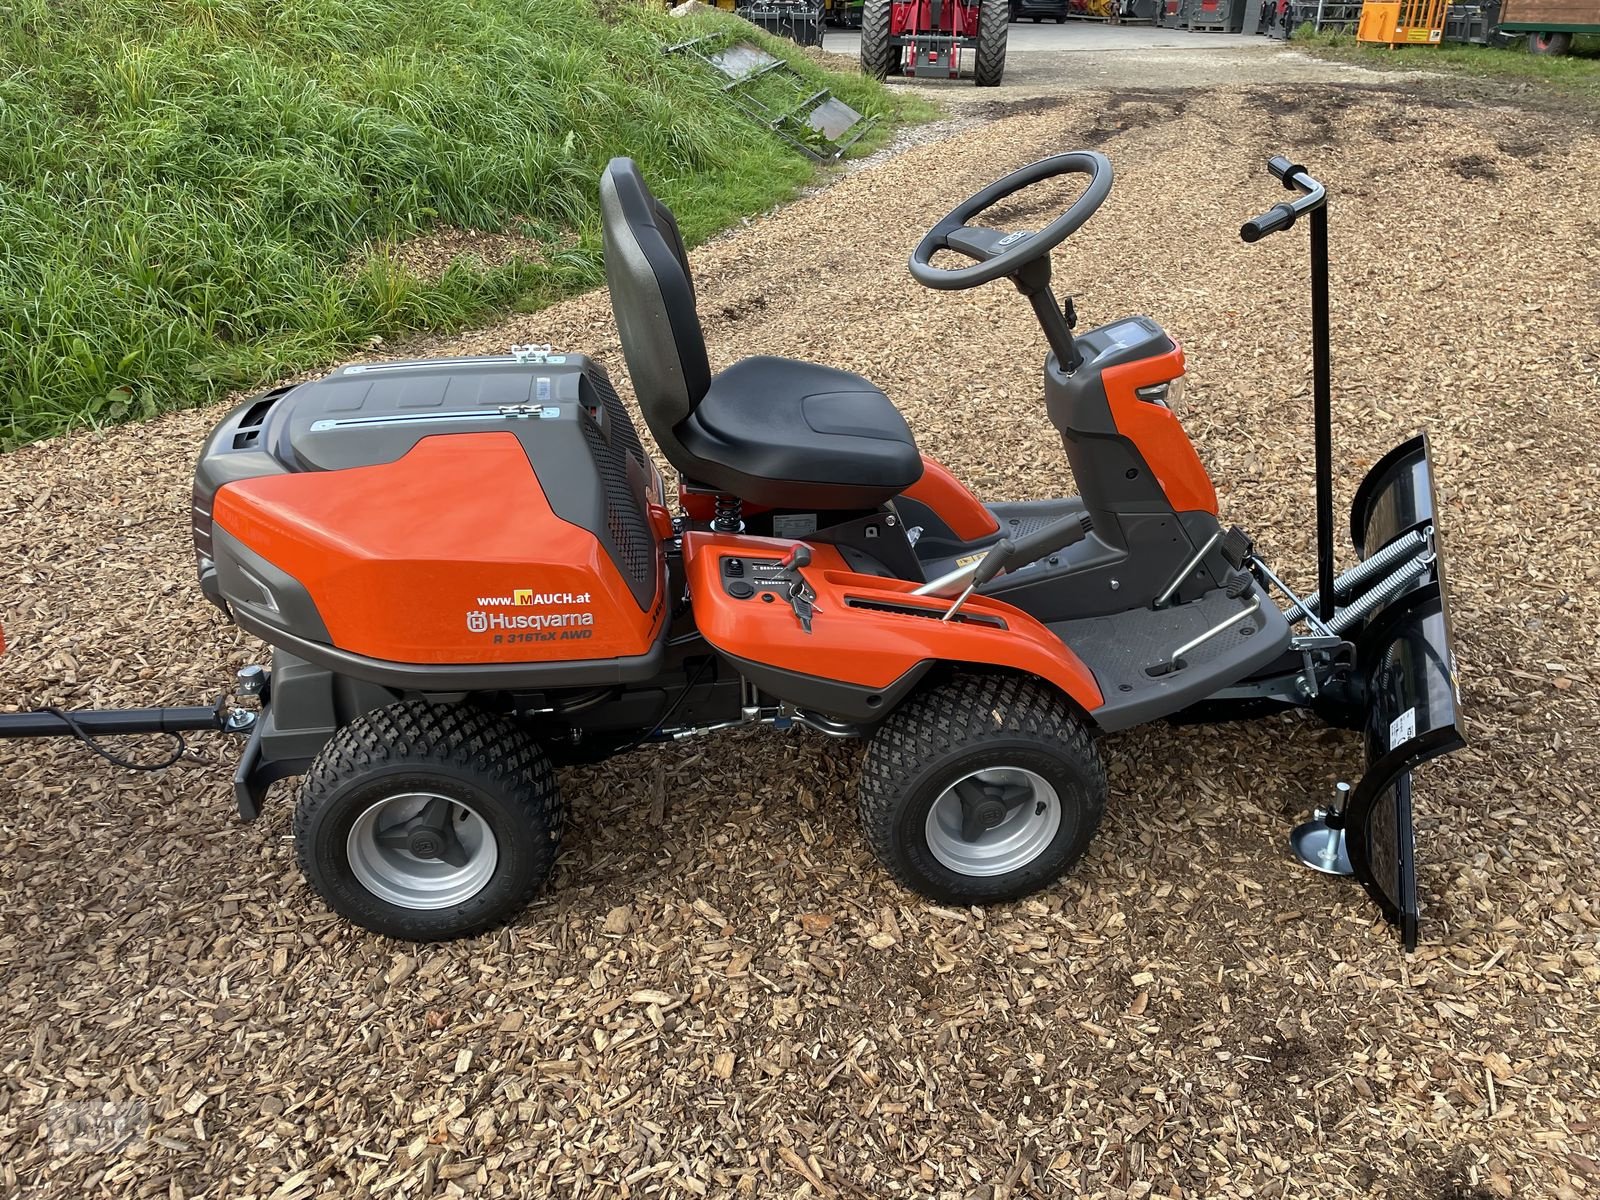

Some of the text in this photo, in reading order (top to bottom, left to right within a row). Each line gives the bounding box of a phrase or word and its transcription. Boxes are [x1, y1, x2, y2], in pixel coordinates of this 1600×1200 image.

[477, 591, 591, 606] www.MAUCH.at
[490, 613, 594, 630] Husqvarna
[493, 635, 503, 644] R
[560, 629, 592, 640] AWD
